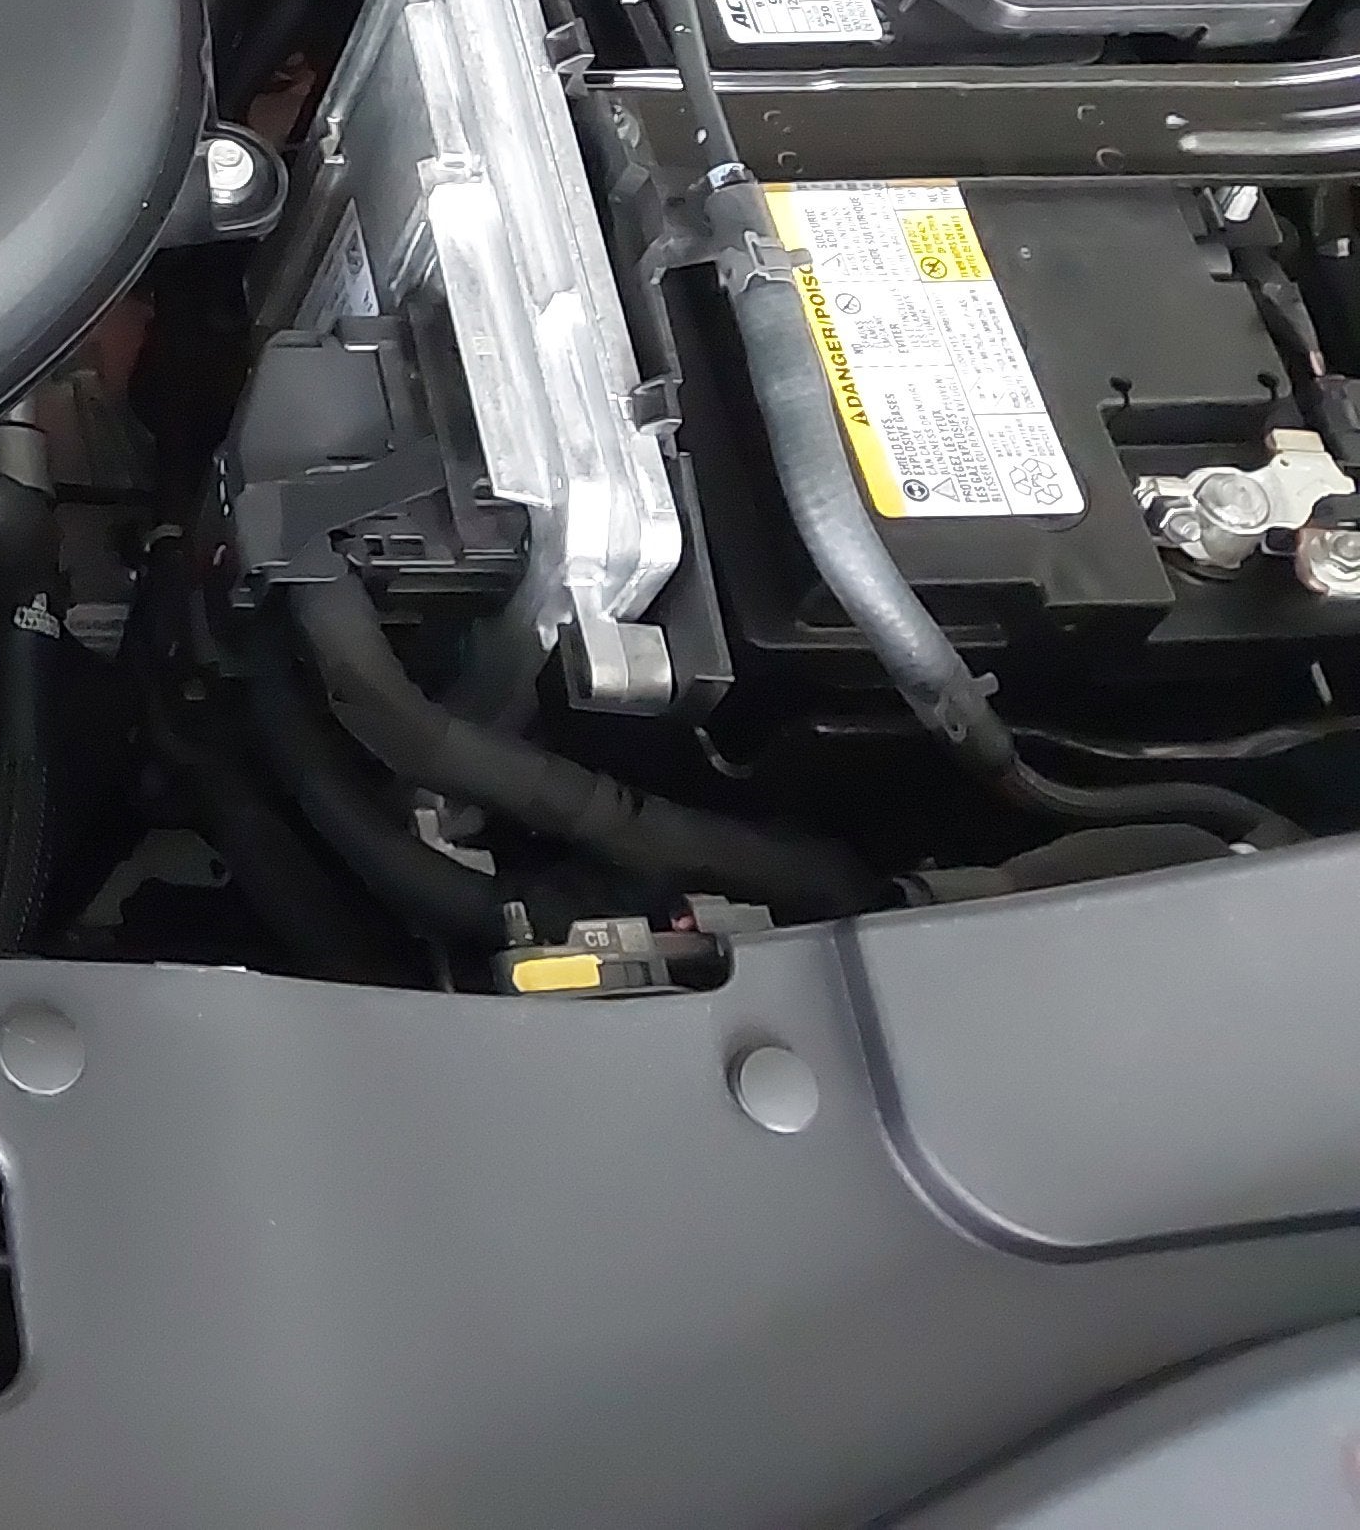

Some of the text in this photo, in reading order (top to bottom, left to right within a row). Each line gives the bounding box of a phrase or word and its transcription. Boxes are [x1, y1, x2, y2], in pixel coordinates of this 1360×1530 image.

[931, 409, 949, 433] YEUX
[880, 418, 913, 475] SHIELD EYES
[941, 436, 957, 452] LES
[945, 413, 974, 462] EXPLOSIFS
[896, 425, 925, 475] EXPLOSIVE
[965, 465, 982, 484] GAZ
[974, 486, 990, 503] LES
[584, 931, 610, 947] CB
